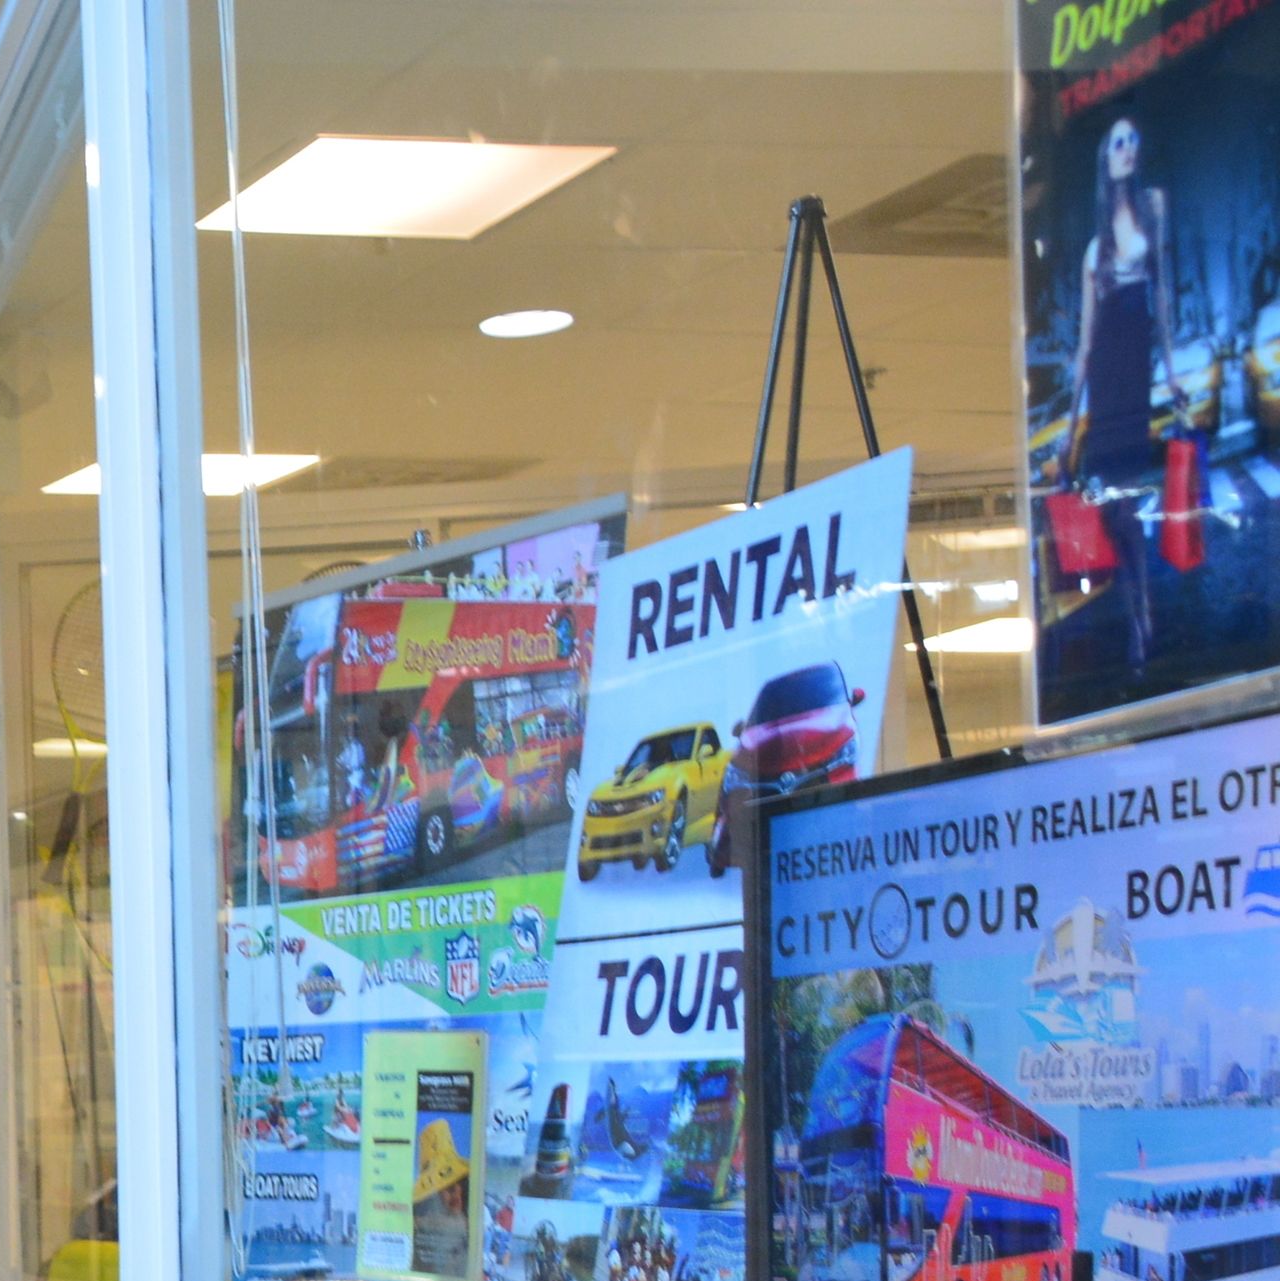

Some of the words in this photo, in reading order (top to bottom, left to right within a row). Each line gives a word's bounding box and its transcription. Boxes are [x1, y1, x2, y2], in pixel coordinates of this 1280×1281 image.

[1050, 0, 1166, 68] Dolp
[627, 511, 856, 661] RENTAL
[777, 835, 877, 883] RESERVA
[883, 827, 920, 867] UN
[925, 813, 1000, 859] TOUR
[1005, 808, 1023, 847] Y
[1031, 785, 1160, 845] REALIZA
[1172, 776, 1208, 820] EL
[321, 903, 382, 936] VENTA
[388, 901, 413, 930] DE
[417, 891, 497, 928] TICKETS
[777, 906, 864, 957] CITY
[916, 883, 1039, 942] TOUR
[1127, 857, 1241, 920] BOAT
[449, 960, 479, 996] NFL
[242, 1037, 279, 1063] KEY
[280, 1034, 325, 1063] WEST
[1019, 1050, 1082, 1081] Lola's
[1090, 1049, 1153, 1078] Tours
[492, 1108, 529, 1134] Sea
[282, 1173, 319, 1201] TOURS
